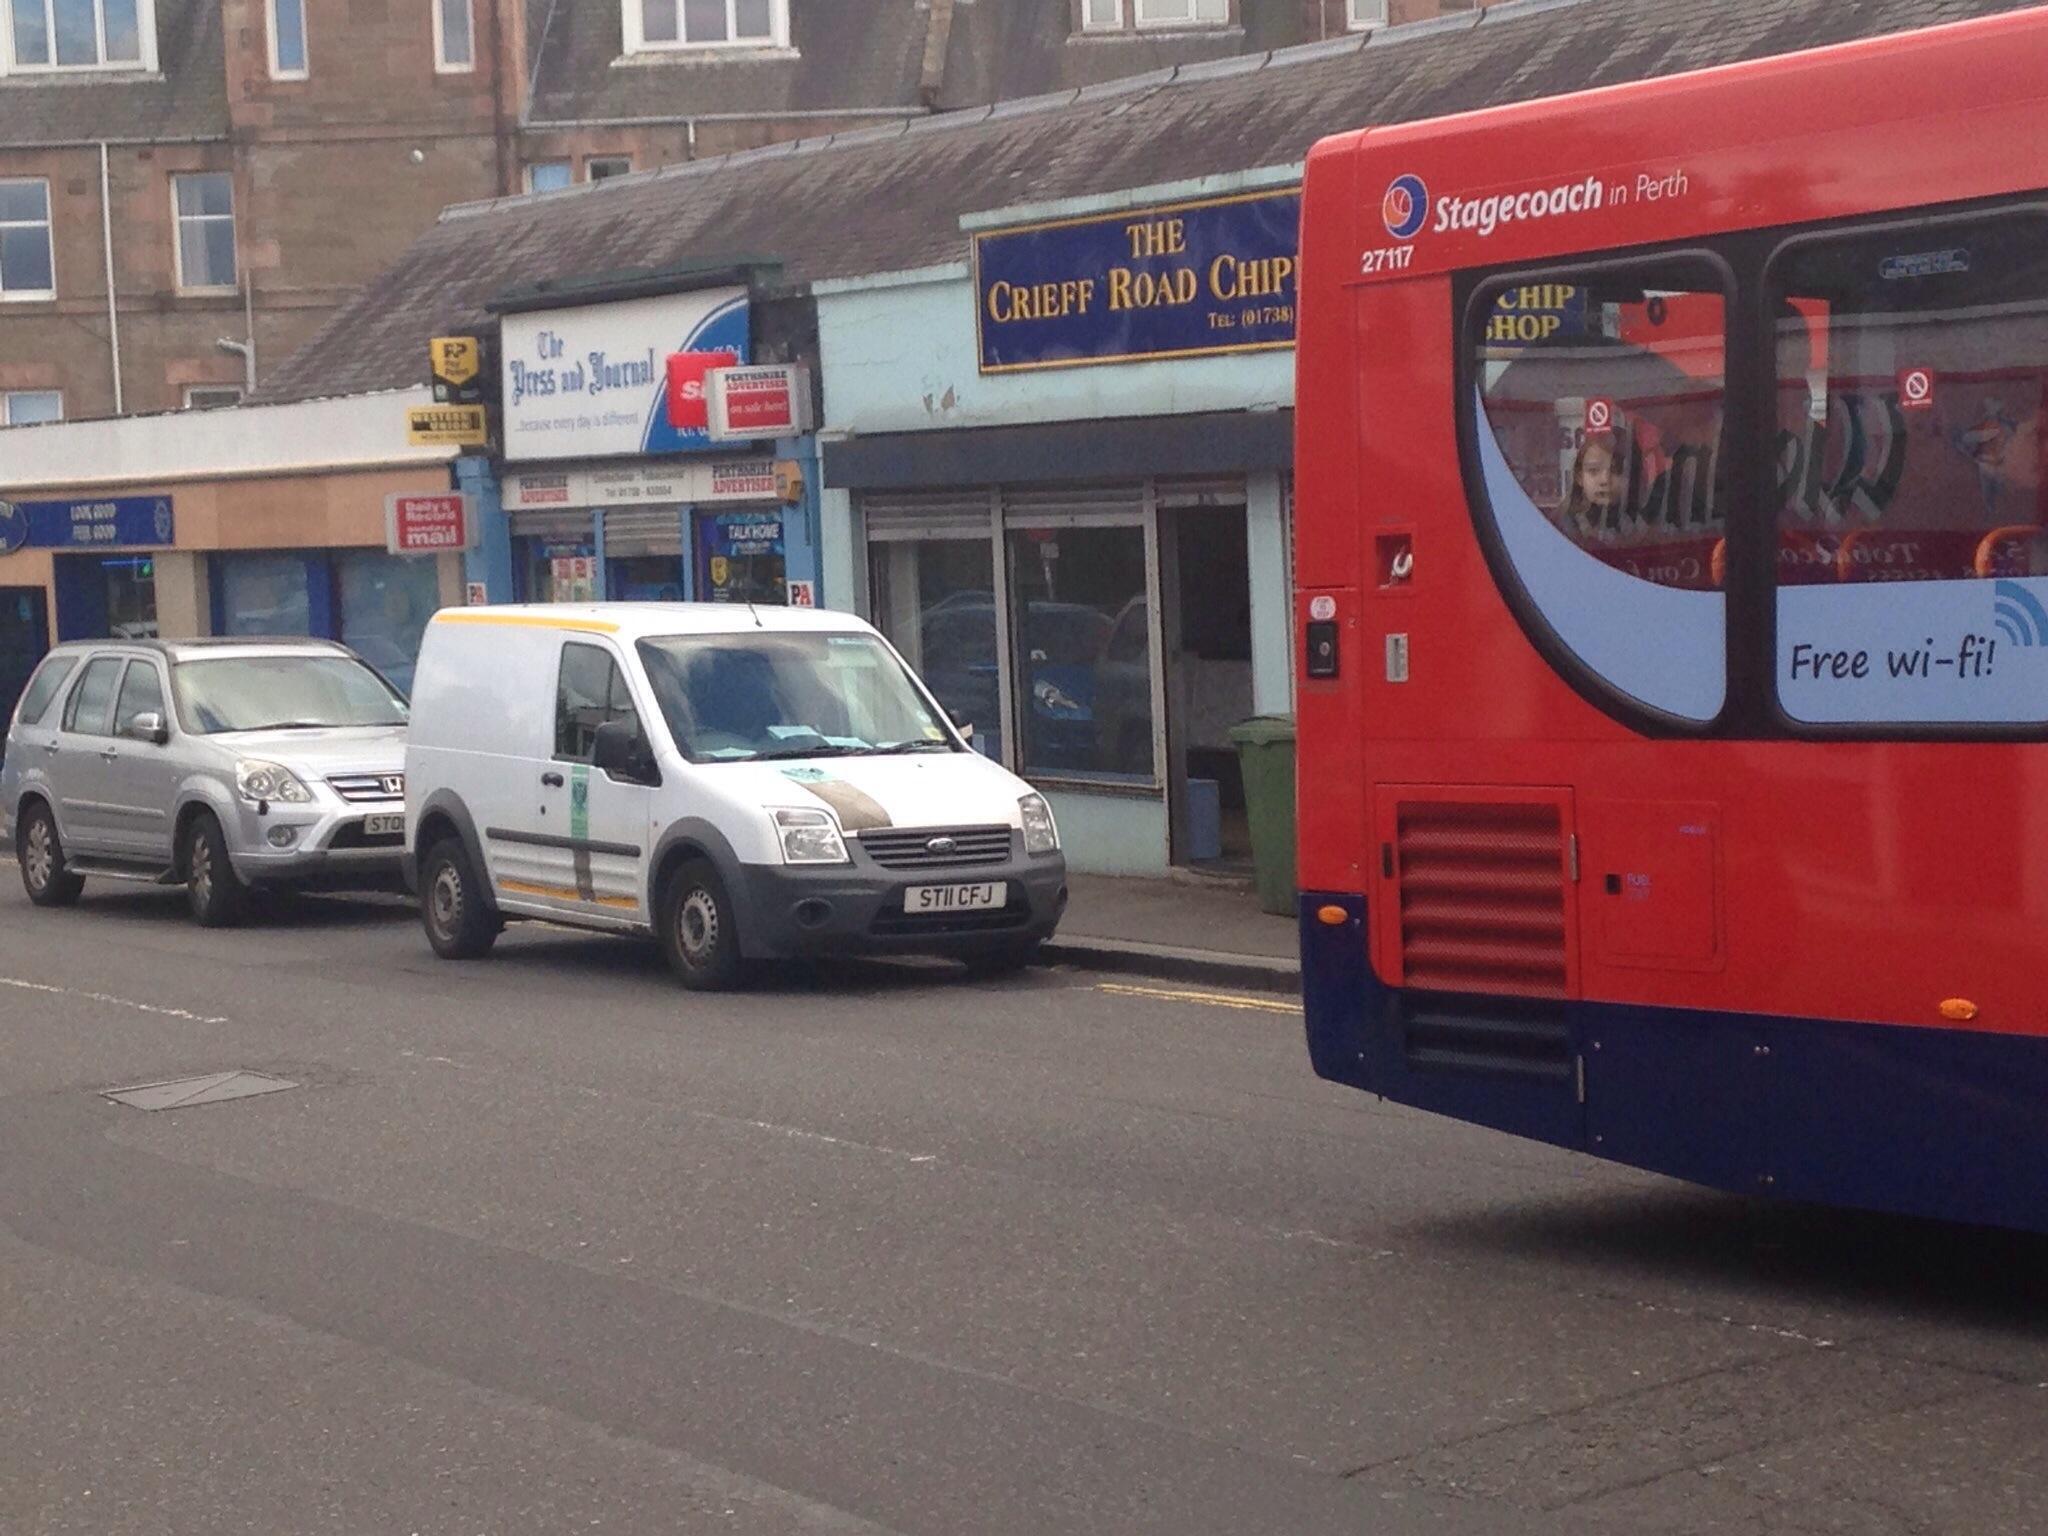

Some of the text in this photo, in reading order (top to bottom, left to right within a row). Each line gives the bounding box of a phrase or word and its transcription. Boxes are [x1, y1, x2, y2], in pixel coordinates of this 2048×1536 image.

[1434, 169, 1688, 236] Stagecoach in Perth
[1126, 218, 1185, 258] THE
[1361, 245, 1415, 274] 27117
[987, 254, 1299, 323] CRIEFF ROAD CHIP
[1497, 284, 1576, 310] CHIP
[538, 330, 564, 360] The
[510, 360, 556, 406] Press
[561, 361, 585, 393] and
[589, 348, 655, 395] Journal
[712, 461, 774, 478] PERTHSHIRE
[712, 476, 775, 494] ADVERTISER
[408, 526, 457, 545] mail
[790, 584, 812, 605] PA
[1791, 633, 1996, 680] Free wi-fi!
[920, 886, 992, 907] ST11 CFJ
